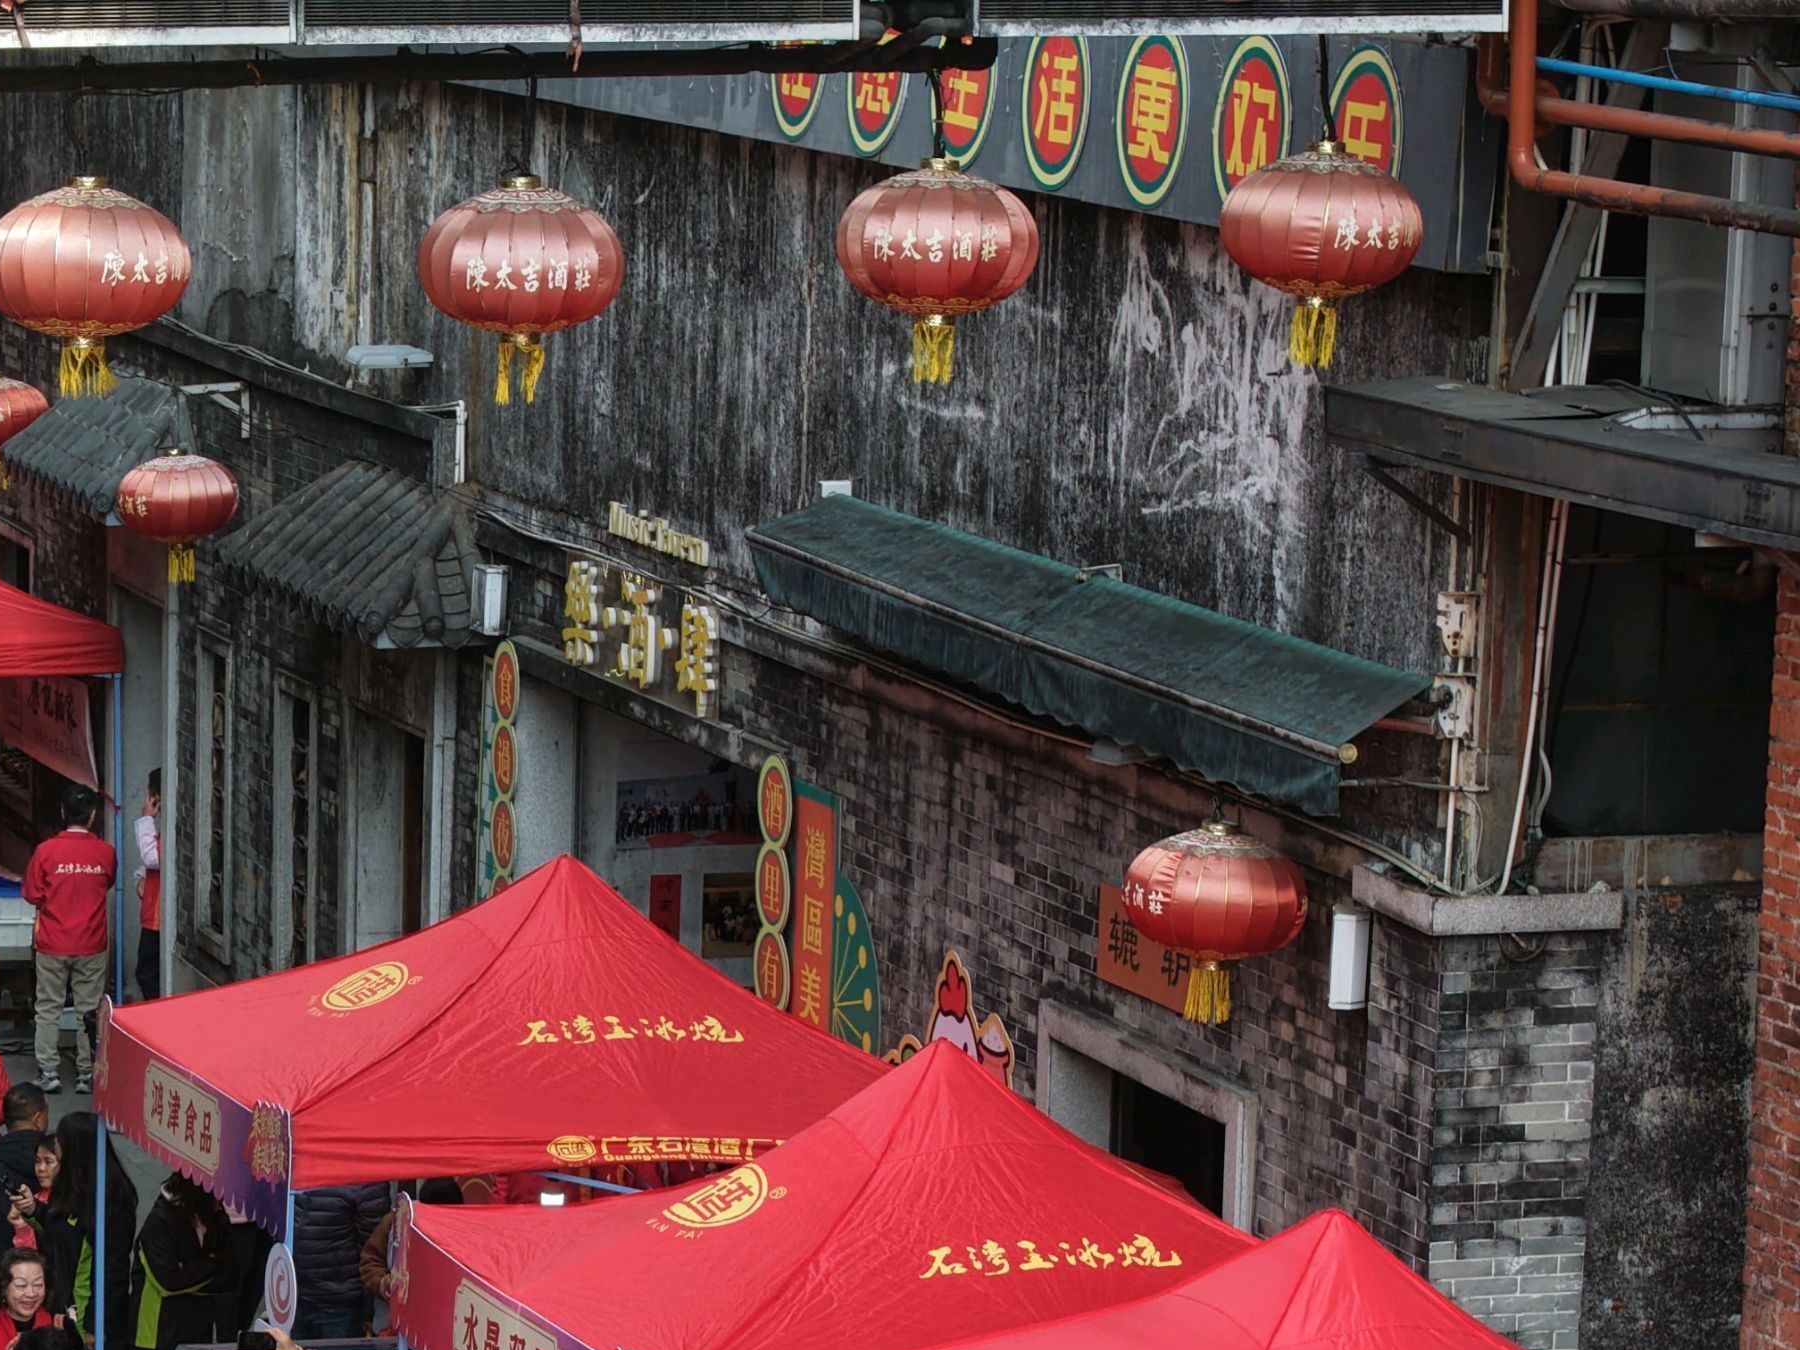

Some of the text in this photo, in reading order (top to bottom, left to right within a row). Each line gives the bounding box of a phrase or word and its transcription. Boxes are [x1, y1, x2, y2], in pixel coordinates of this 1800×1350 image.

[873, 226, 999, 264] 陳太吉酒莊
[101, 252, 189, 285] 陳太吉酒
[465, 257, 592, 294] 陳太吉酒莊
[151, 1079, 212, 1155] 鸿津食品
[600, 1136, 785, 1157] 广东石湾酒厂
